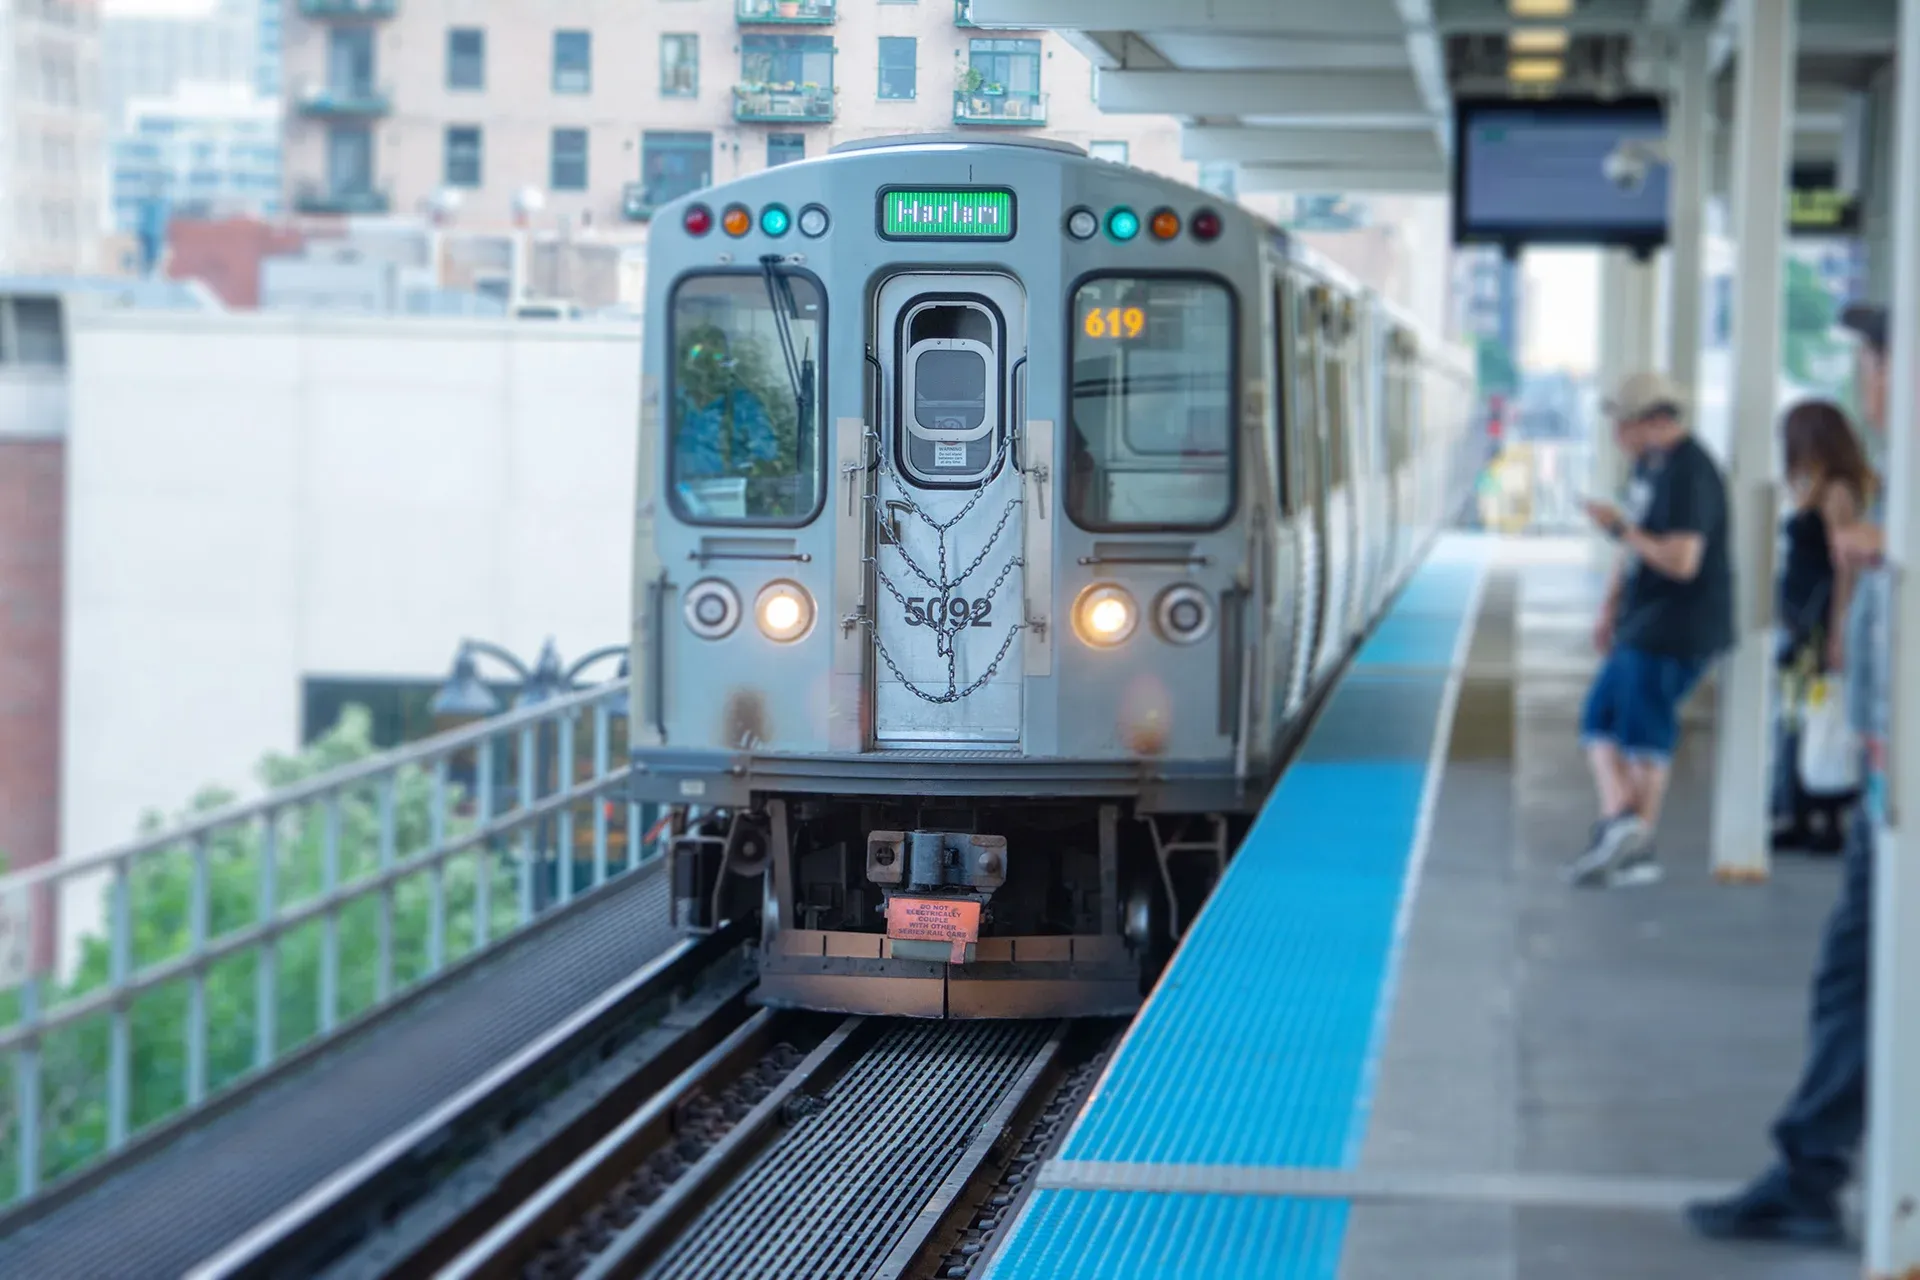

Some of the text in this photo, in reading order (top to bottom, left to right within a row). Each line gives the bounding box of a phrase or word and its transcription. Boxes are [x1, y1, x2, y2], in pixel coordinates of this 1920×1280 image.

[1085, 306, 1145, 338] 619
[904, 596, 992, 627] 5092
[906, 909, 961, 917] ELECTRICALLY
